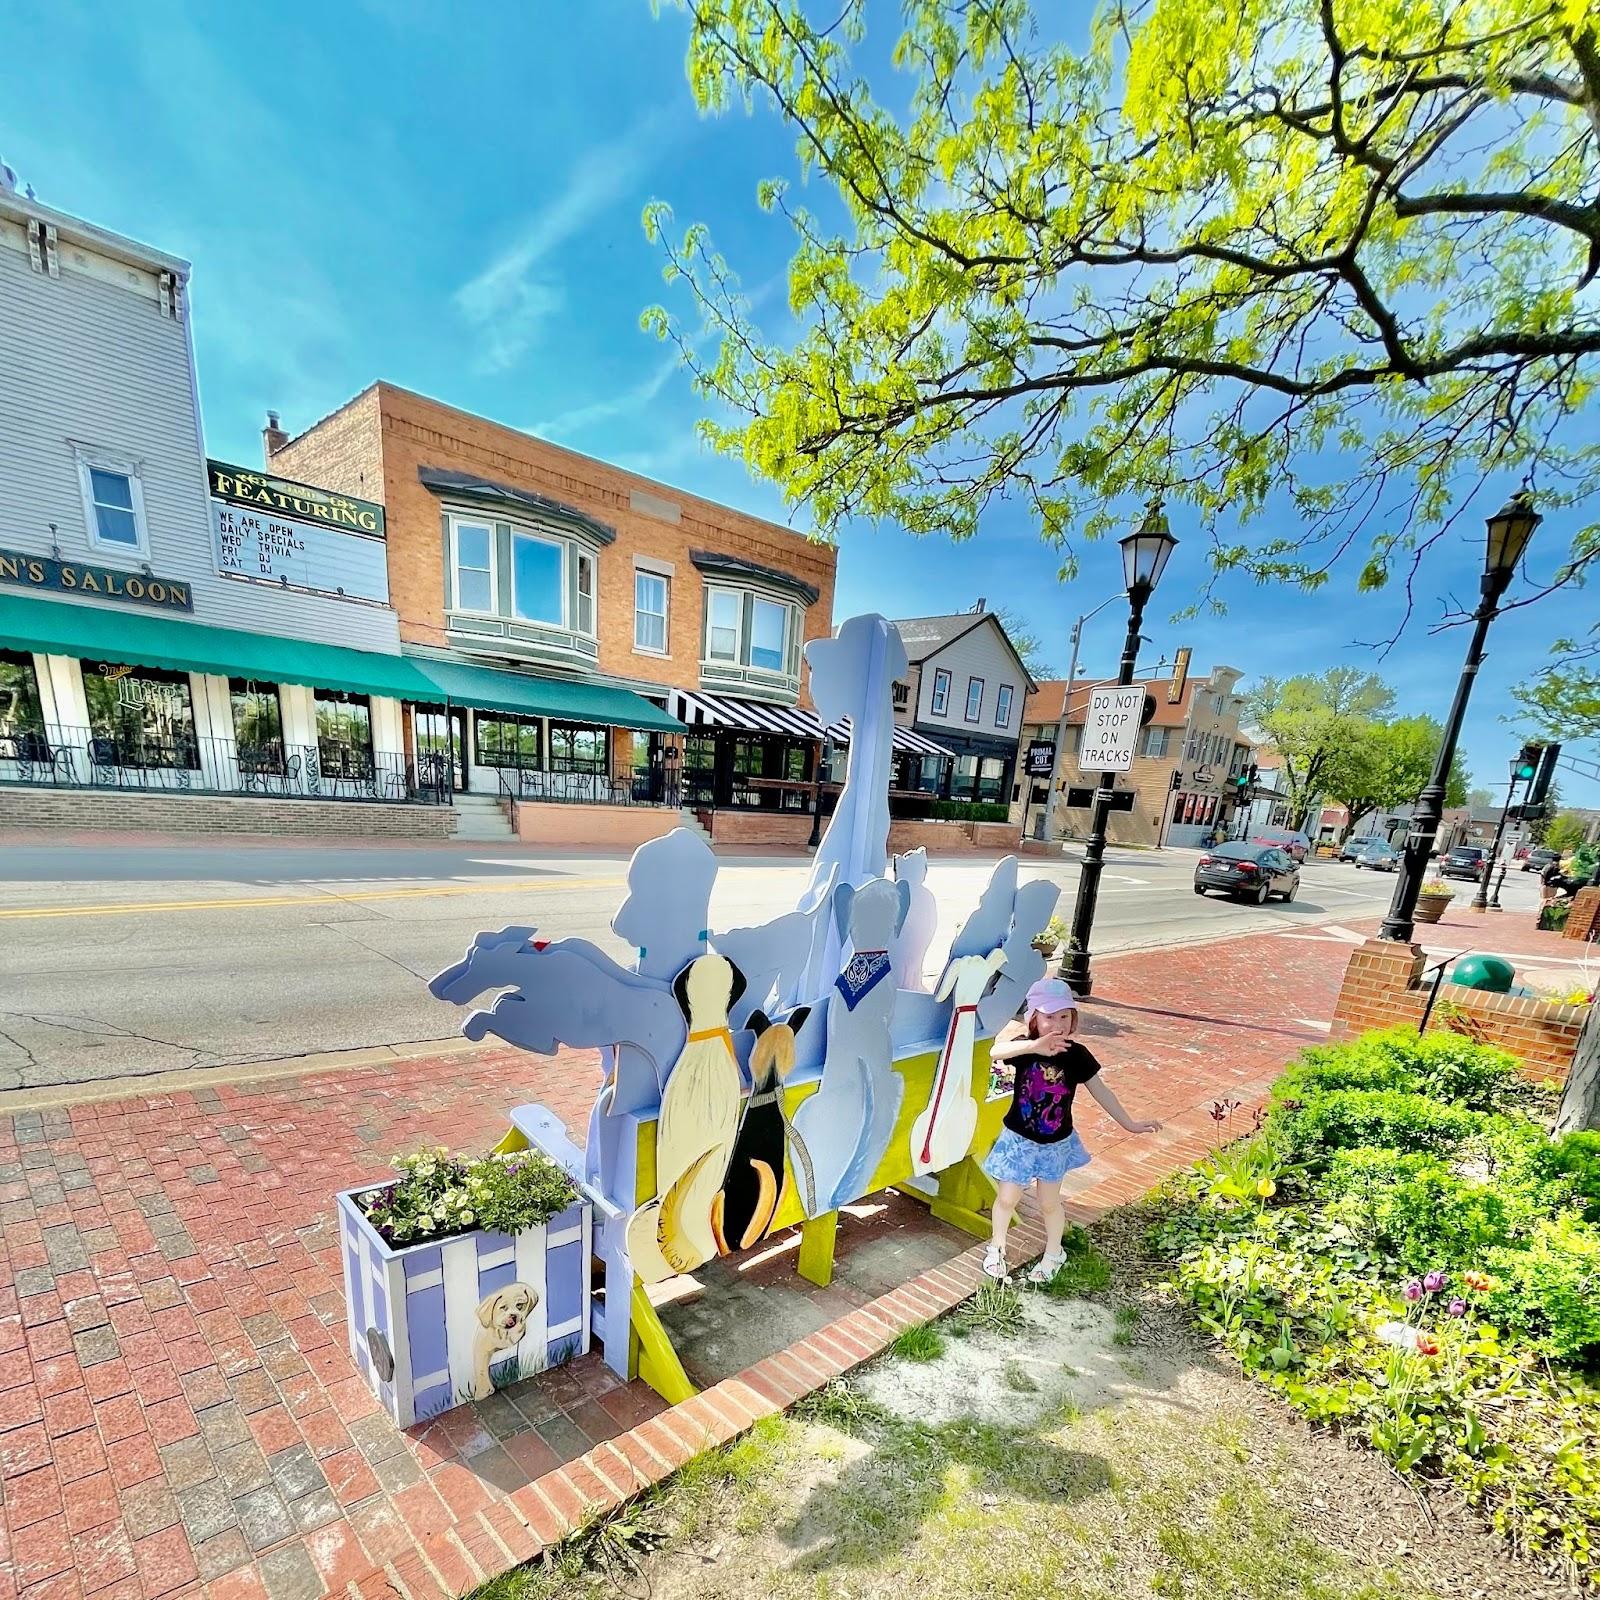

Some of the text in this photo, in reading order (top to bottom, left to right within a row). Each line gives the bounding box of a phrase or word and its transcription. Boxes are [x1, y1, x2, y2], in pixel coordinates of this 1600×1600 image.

[214, 470, 377, 531] FEATURING
[219, 511, 293, 538] WE ARE OPEN
[220, 522, 305, 551] DAILY SPECIALS
[221, 533, 292, 558] WED TRIVIA
[222, 545, 271, 563] FRI DJ
[223, 555, 272, 574] SAT DJ
[61, 566, 188, 606] SALOON
[1094, 695, 1139, 709] DO NOT
[1097, 714, 1129, 727] STOP
[1101, 732, 1119, 744] ON
[1034, 755, 1049, 765] CUT
[1085, 749, 1130, 763] TRACKS
